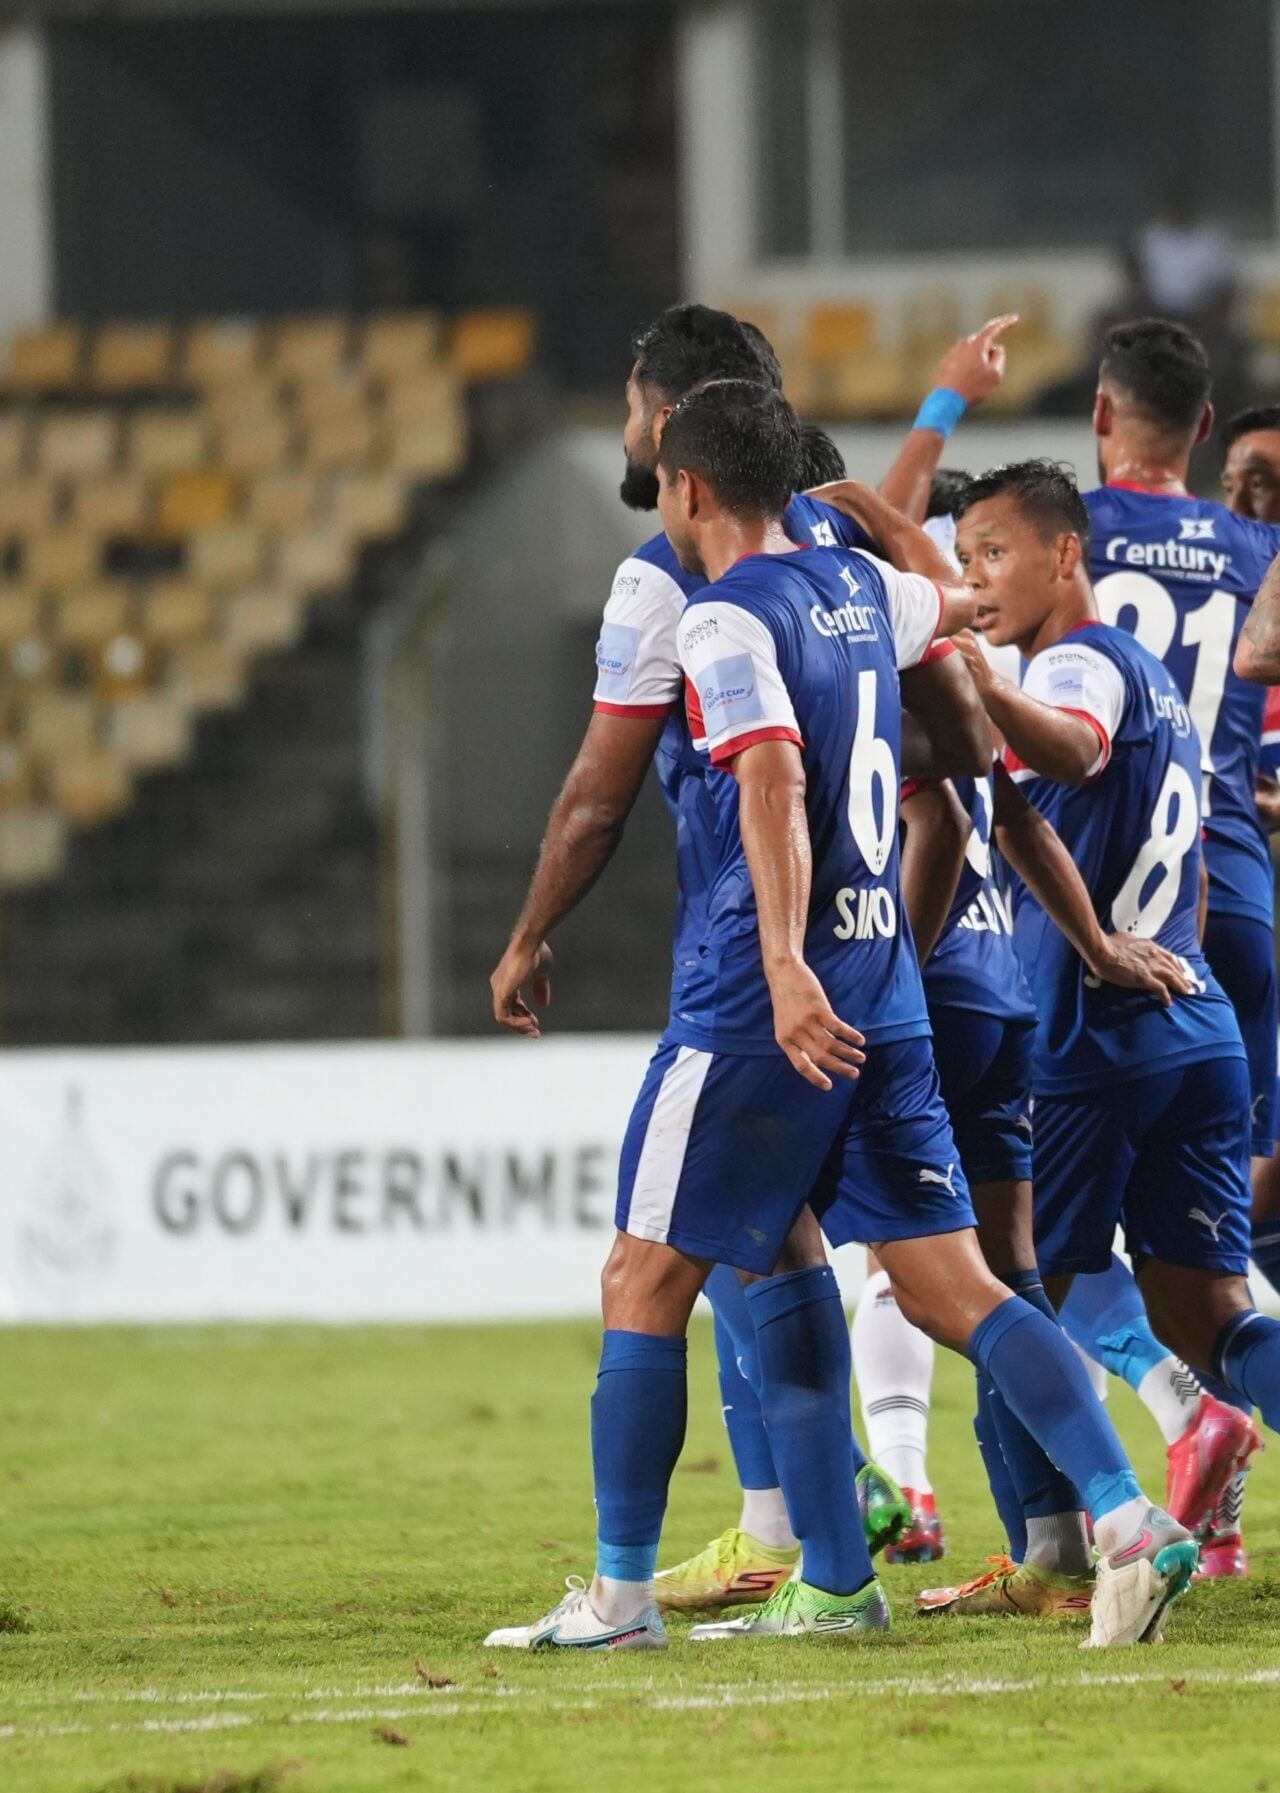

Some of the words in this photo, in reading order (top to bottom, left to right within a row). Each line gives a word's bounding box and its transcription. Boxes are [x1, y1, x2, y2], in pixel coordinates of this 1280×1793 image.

[1106, 537, 1226, 580] Century
[848, 671, 897, 877] 6
[1111, 761, 1198, 939] 8
